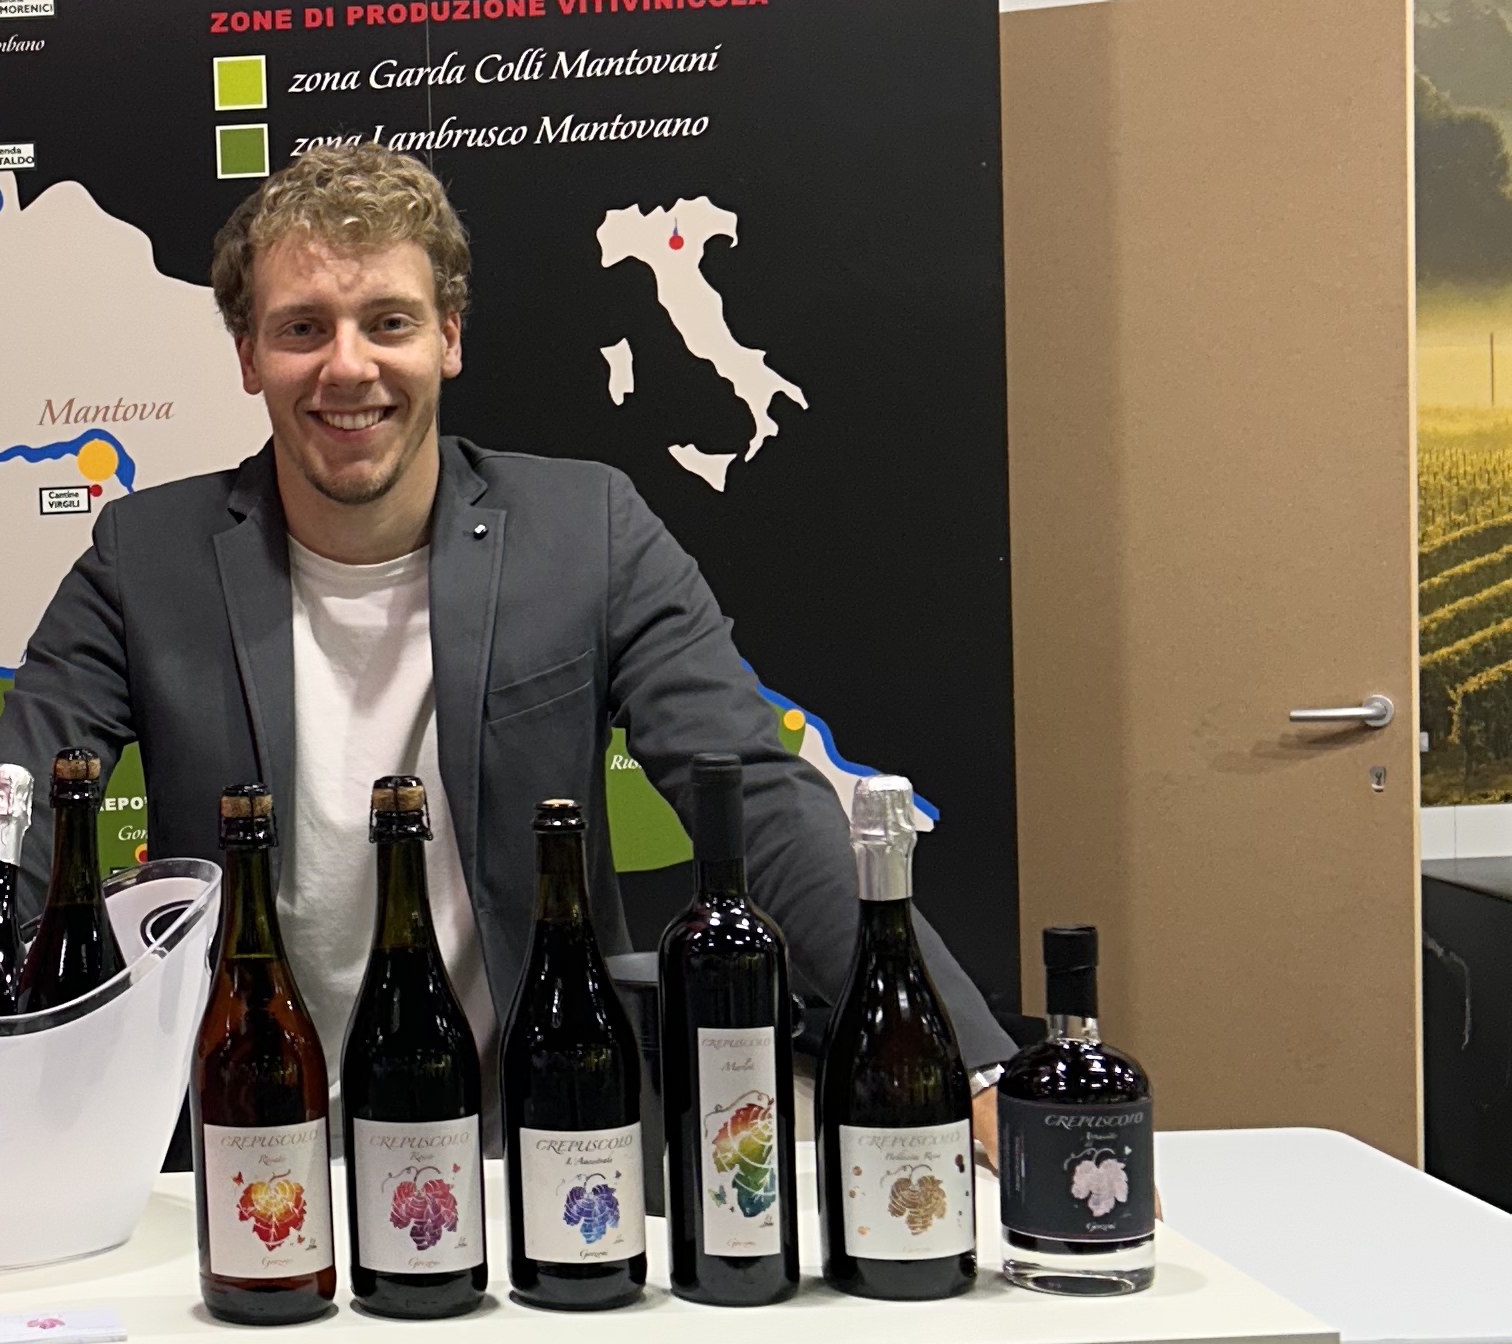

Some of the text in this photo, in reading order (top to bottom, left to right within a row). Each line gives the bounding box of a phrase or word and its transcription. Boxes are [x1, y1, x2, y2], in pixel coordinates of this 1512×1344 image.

[0, 3, 54, 15] MORENICI
[210, 9, 293, 33] ZONE
[304, 7, 334, 29] DI
[288, 43, 723, 93] zona Garda Colli Mantovani
[533, 110, 710, 145] Mantovano
[37, 397, 176, 427] Mantova
[1044, 1112, 1145, 1131] CREPUSCOLO
[220, 1129, 319, 1151] CREPUSCOLO
[369, 1130, 472, 1151] CREPUSCOLO
[536, 1134, 633, 1154] CREPUSCOLO
